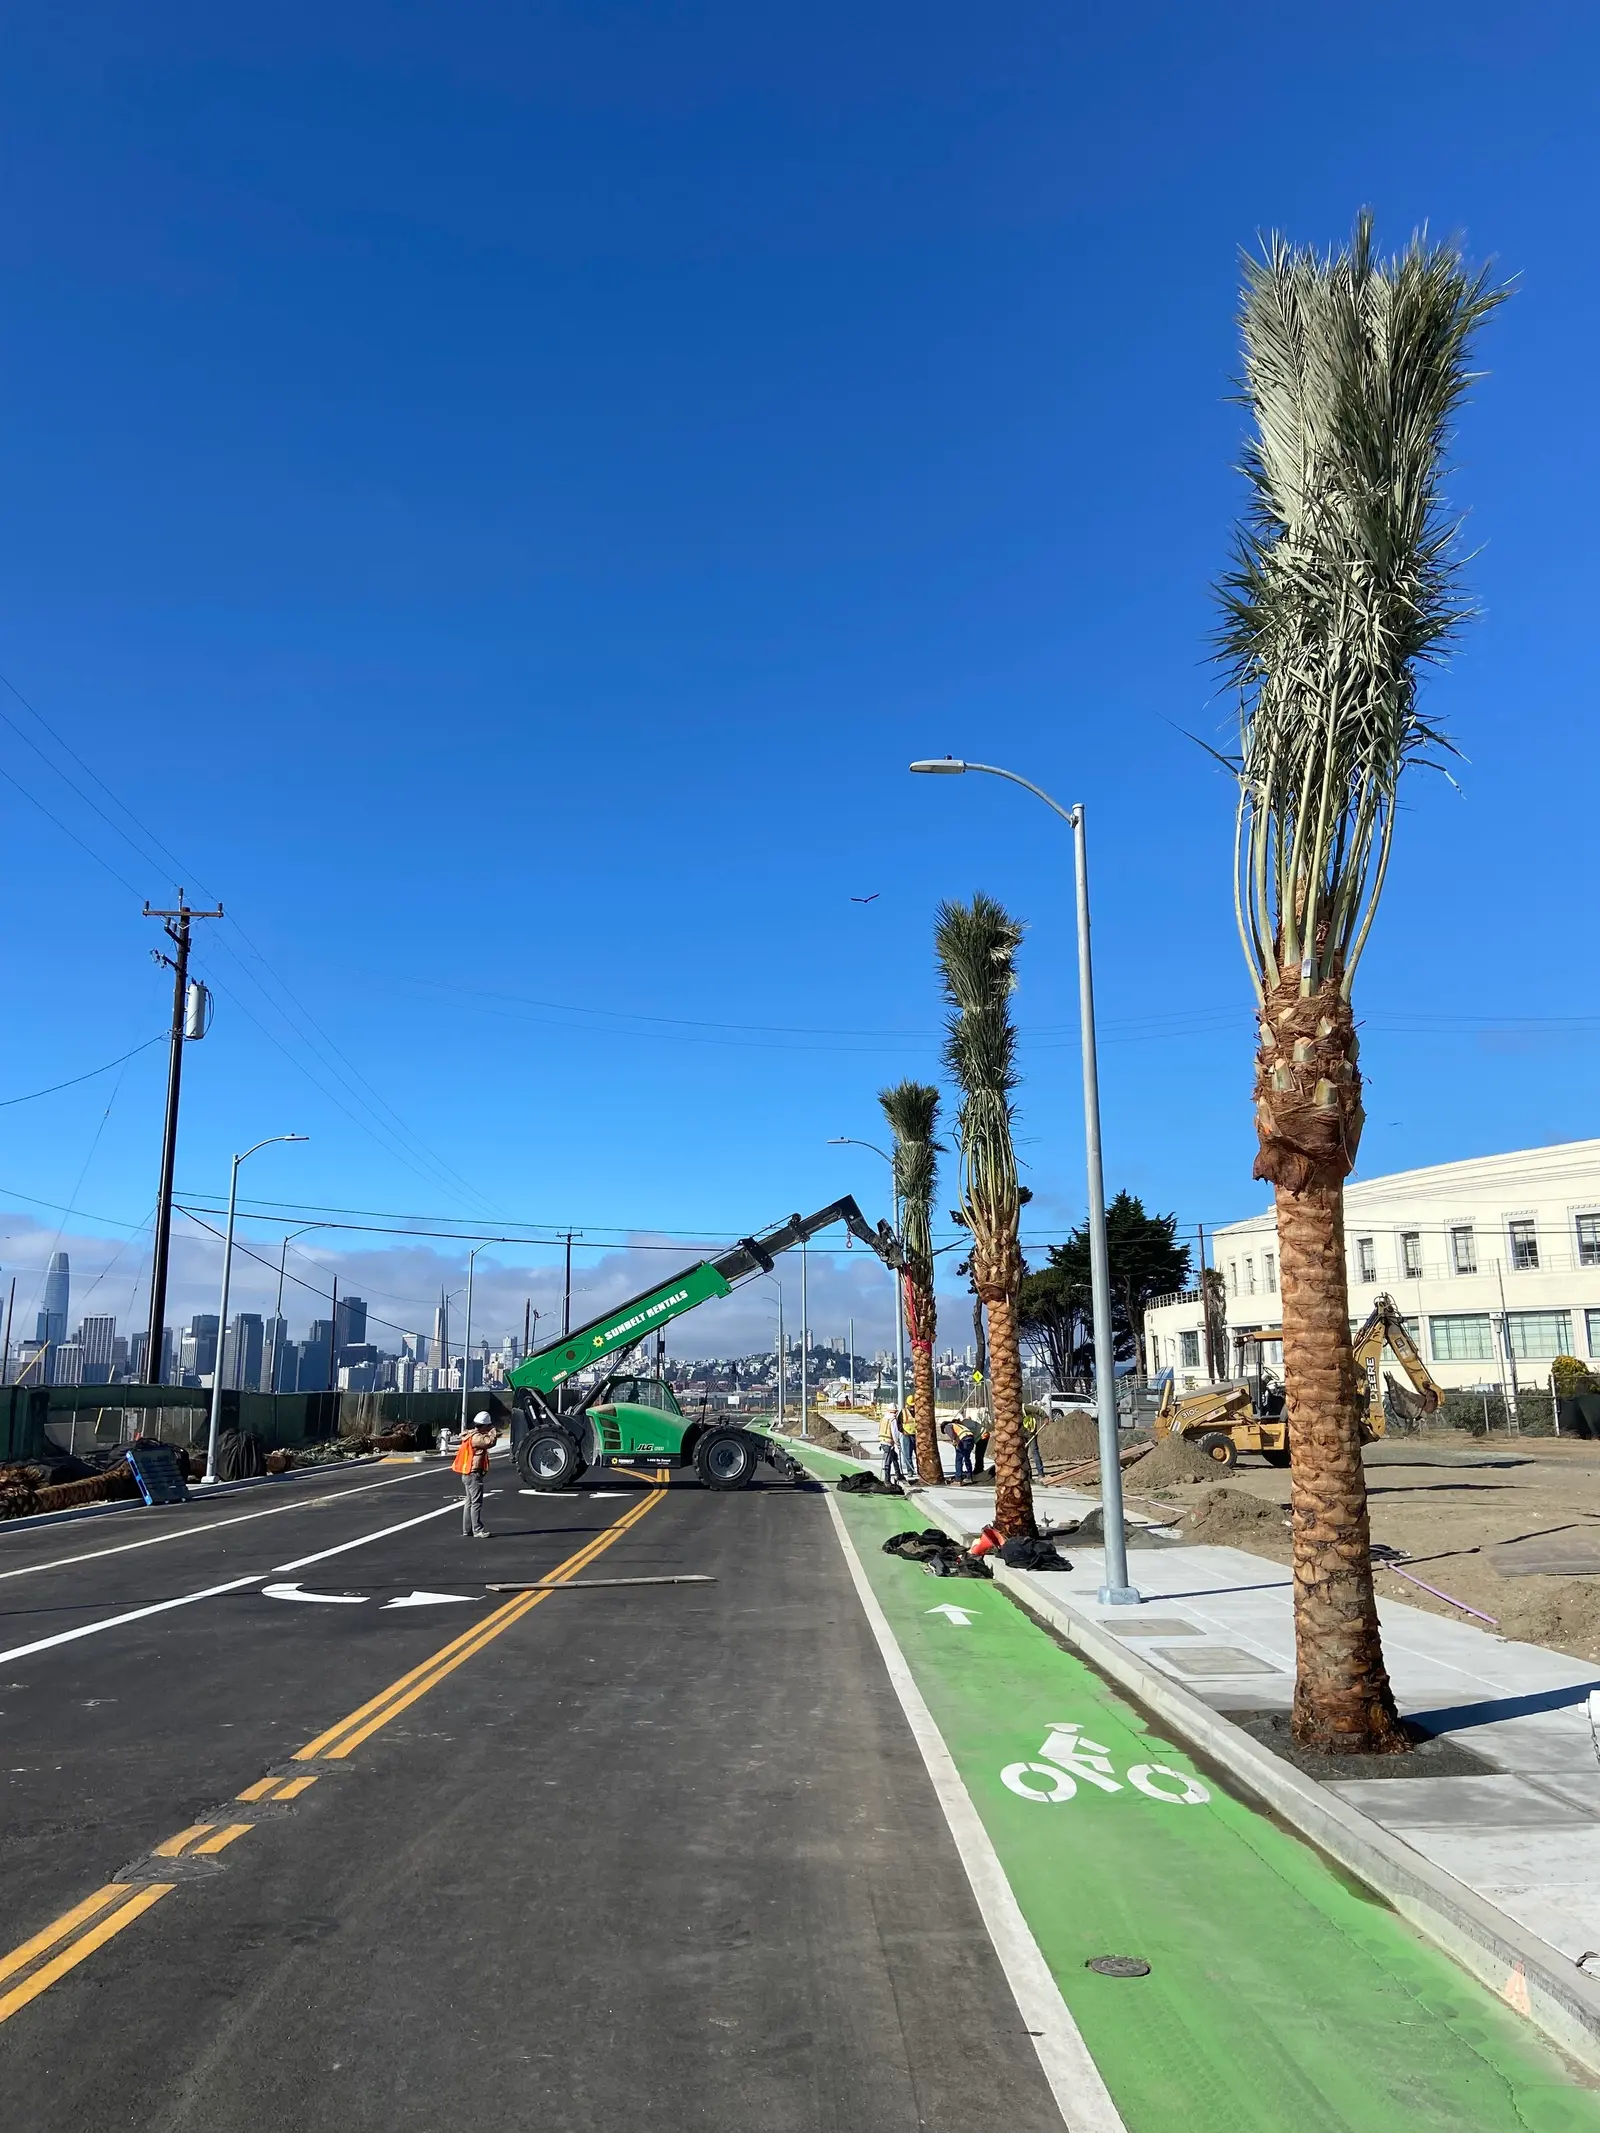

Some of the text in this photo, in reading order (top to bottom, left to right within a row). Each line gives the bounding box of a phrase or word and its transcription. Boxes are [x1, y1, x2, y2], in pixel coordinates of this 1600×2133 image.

[604, 1290, 689, 1341] SUNBELT RENTALS
[1365, 1357, 1379, 1402] DEERE
[636, 1443, 655, 1451] JLG
